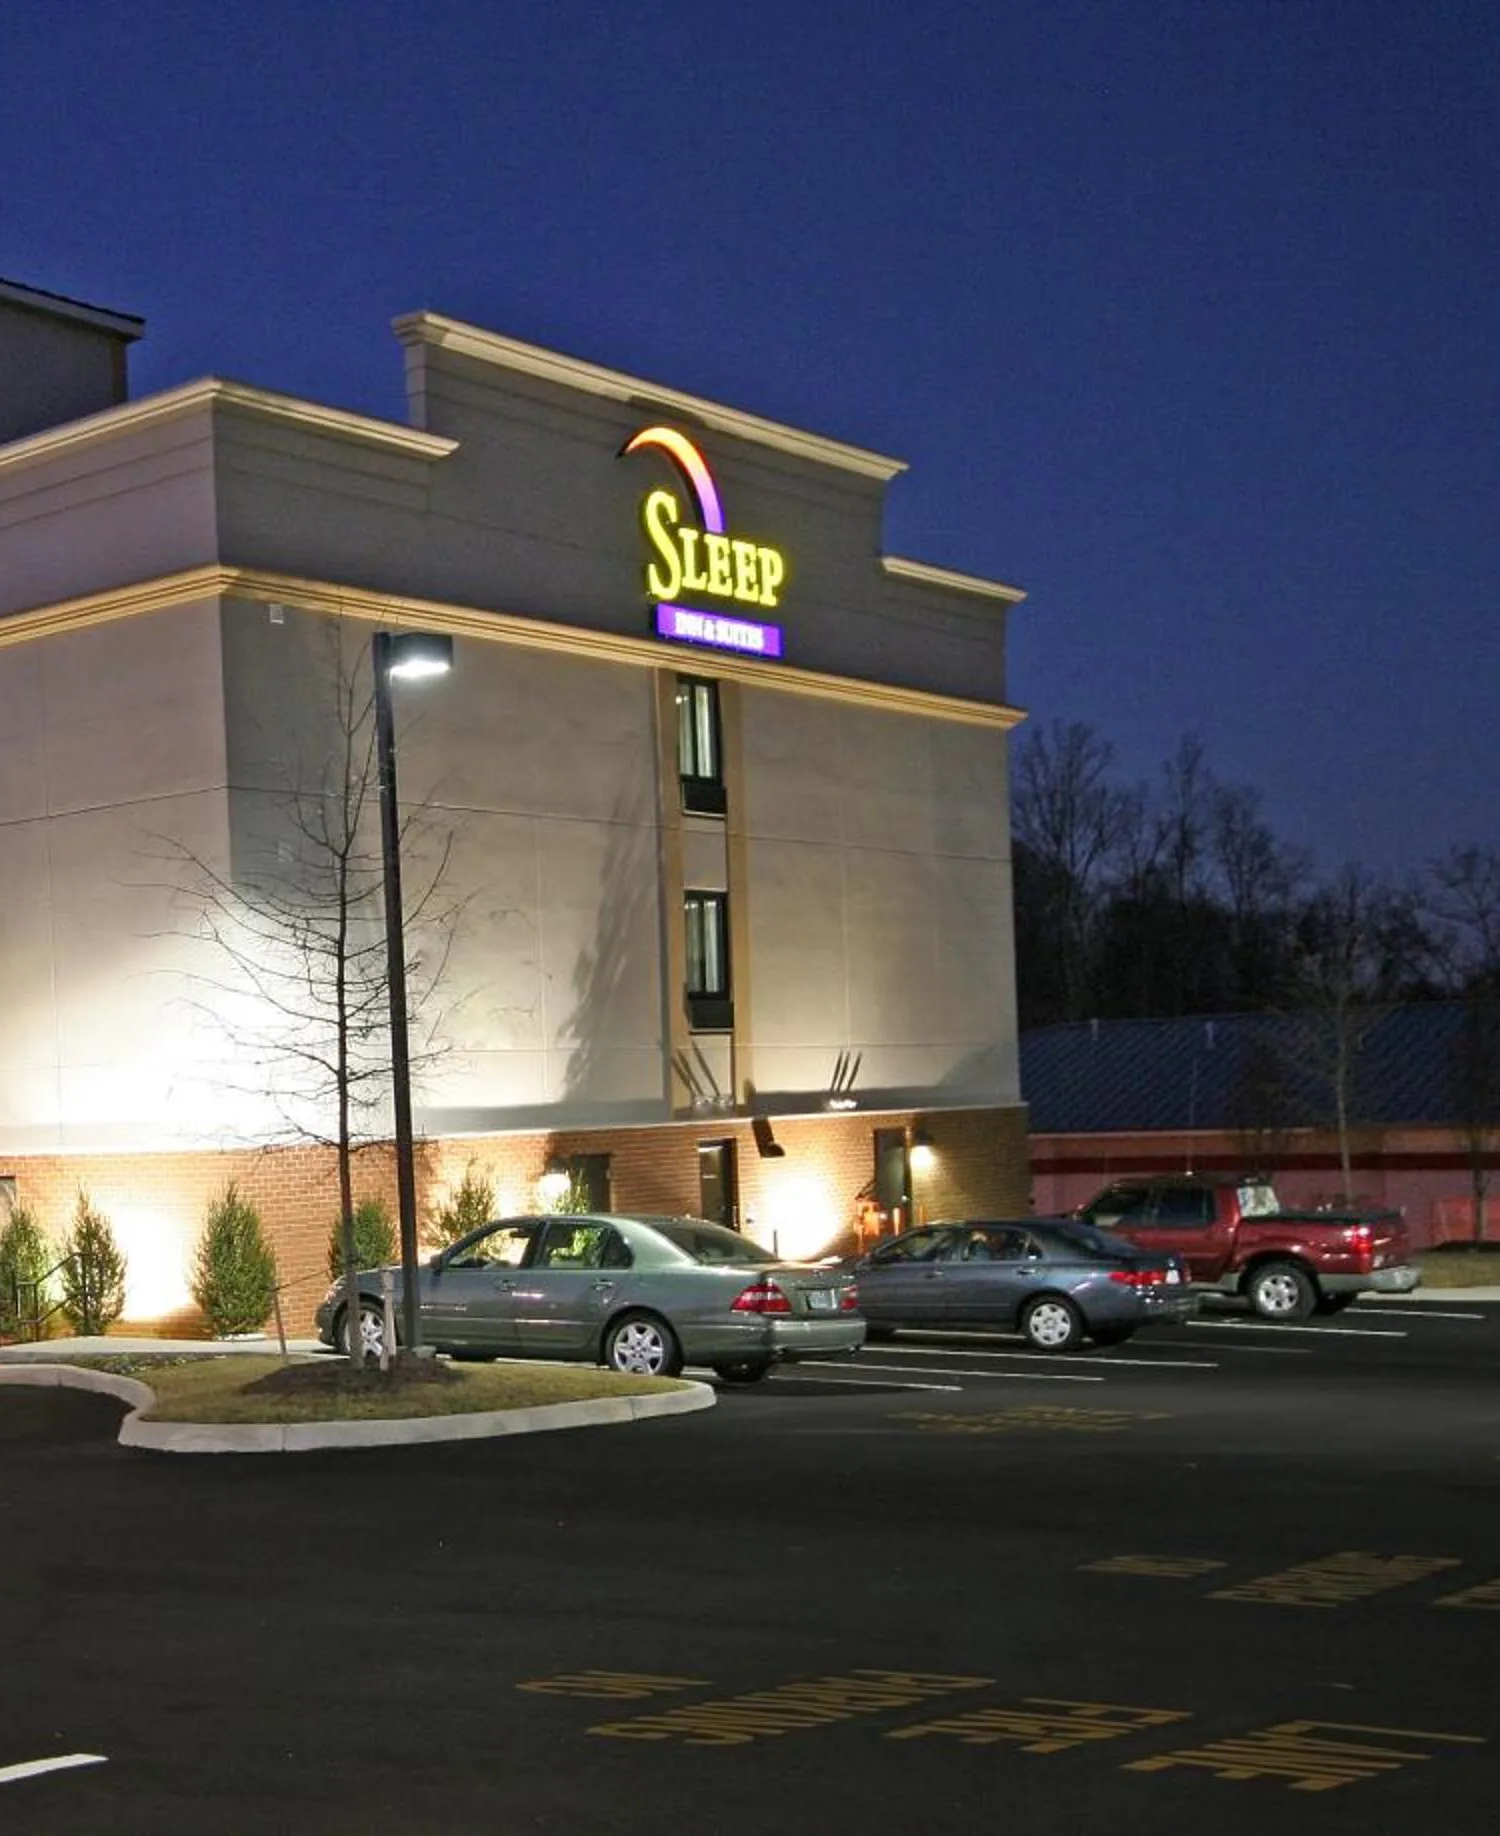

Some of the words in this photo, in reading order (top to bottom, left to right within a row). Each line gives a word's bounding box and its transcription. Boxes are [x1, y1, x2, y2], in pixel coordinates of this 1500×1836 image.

[645, 490, 784, 607] SLEEP
[514, 1668, 716, 1699] NO
[583, 1668, 999, 1746] PARKING
[879, 1697, 1195, 1754] FIRE
[1118, 1719, 1490, 1792] LANE
